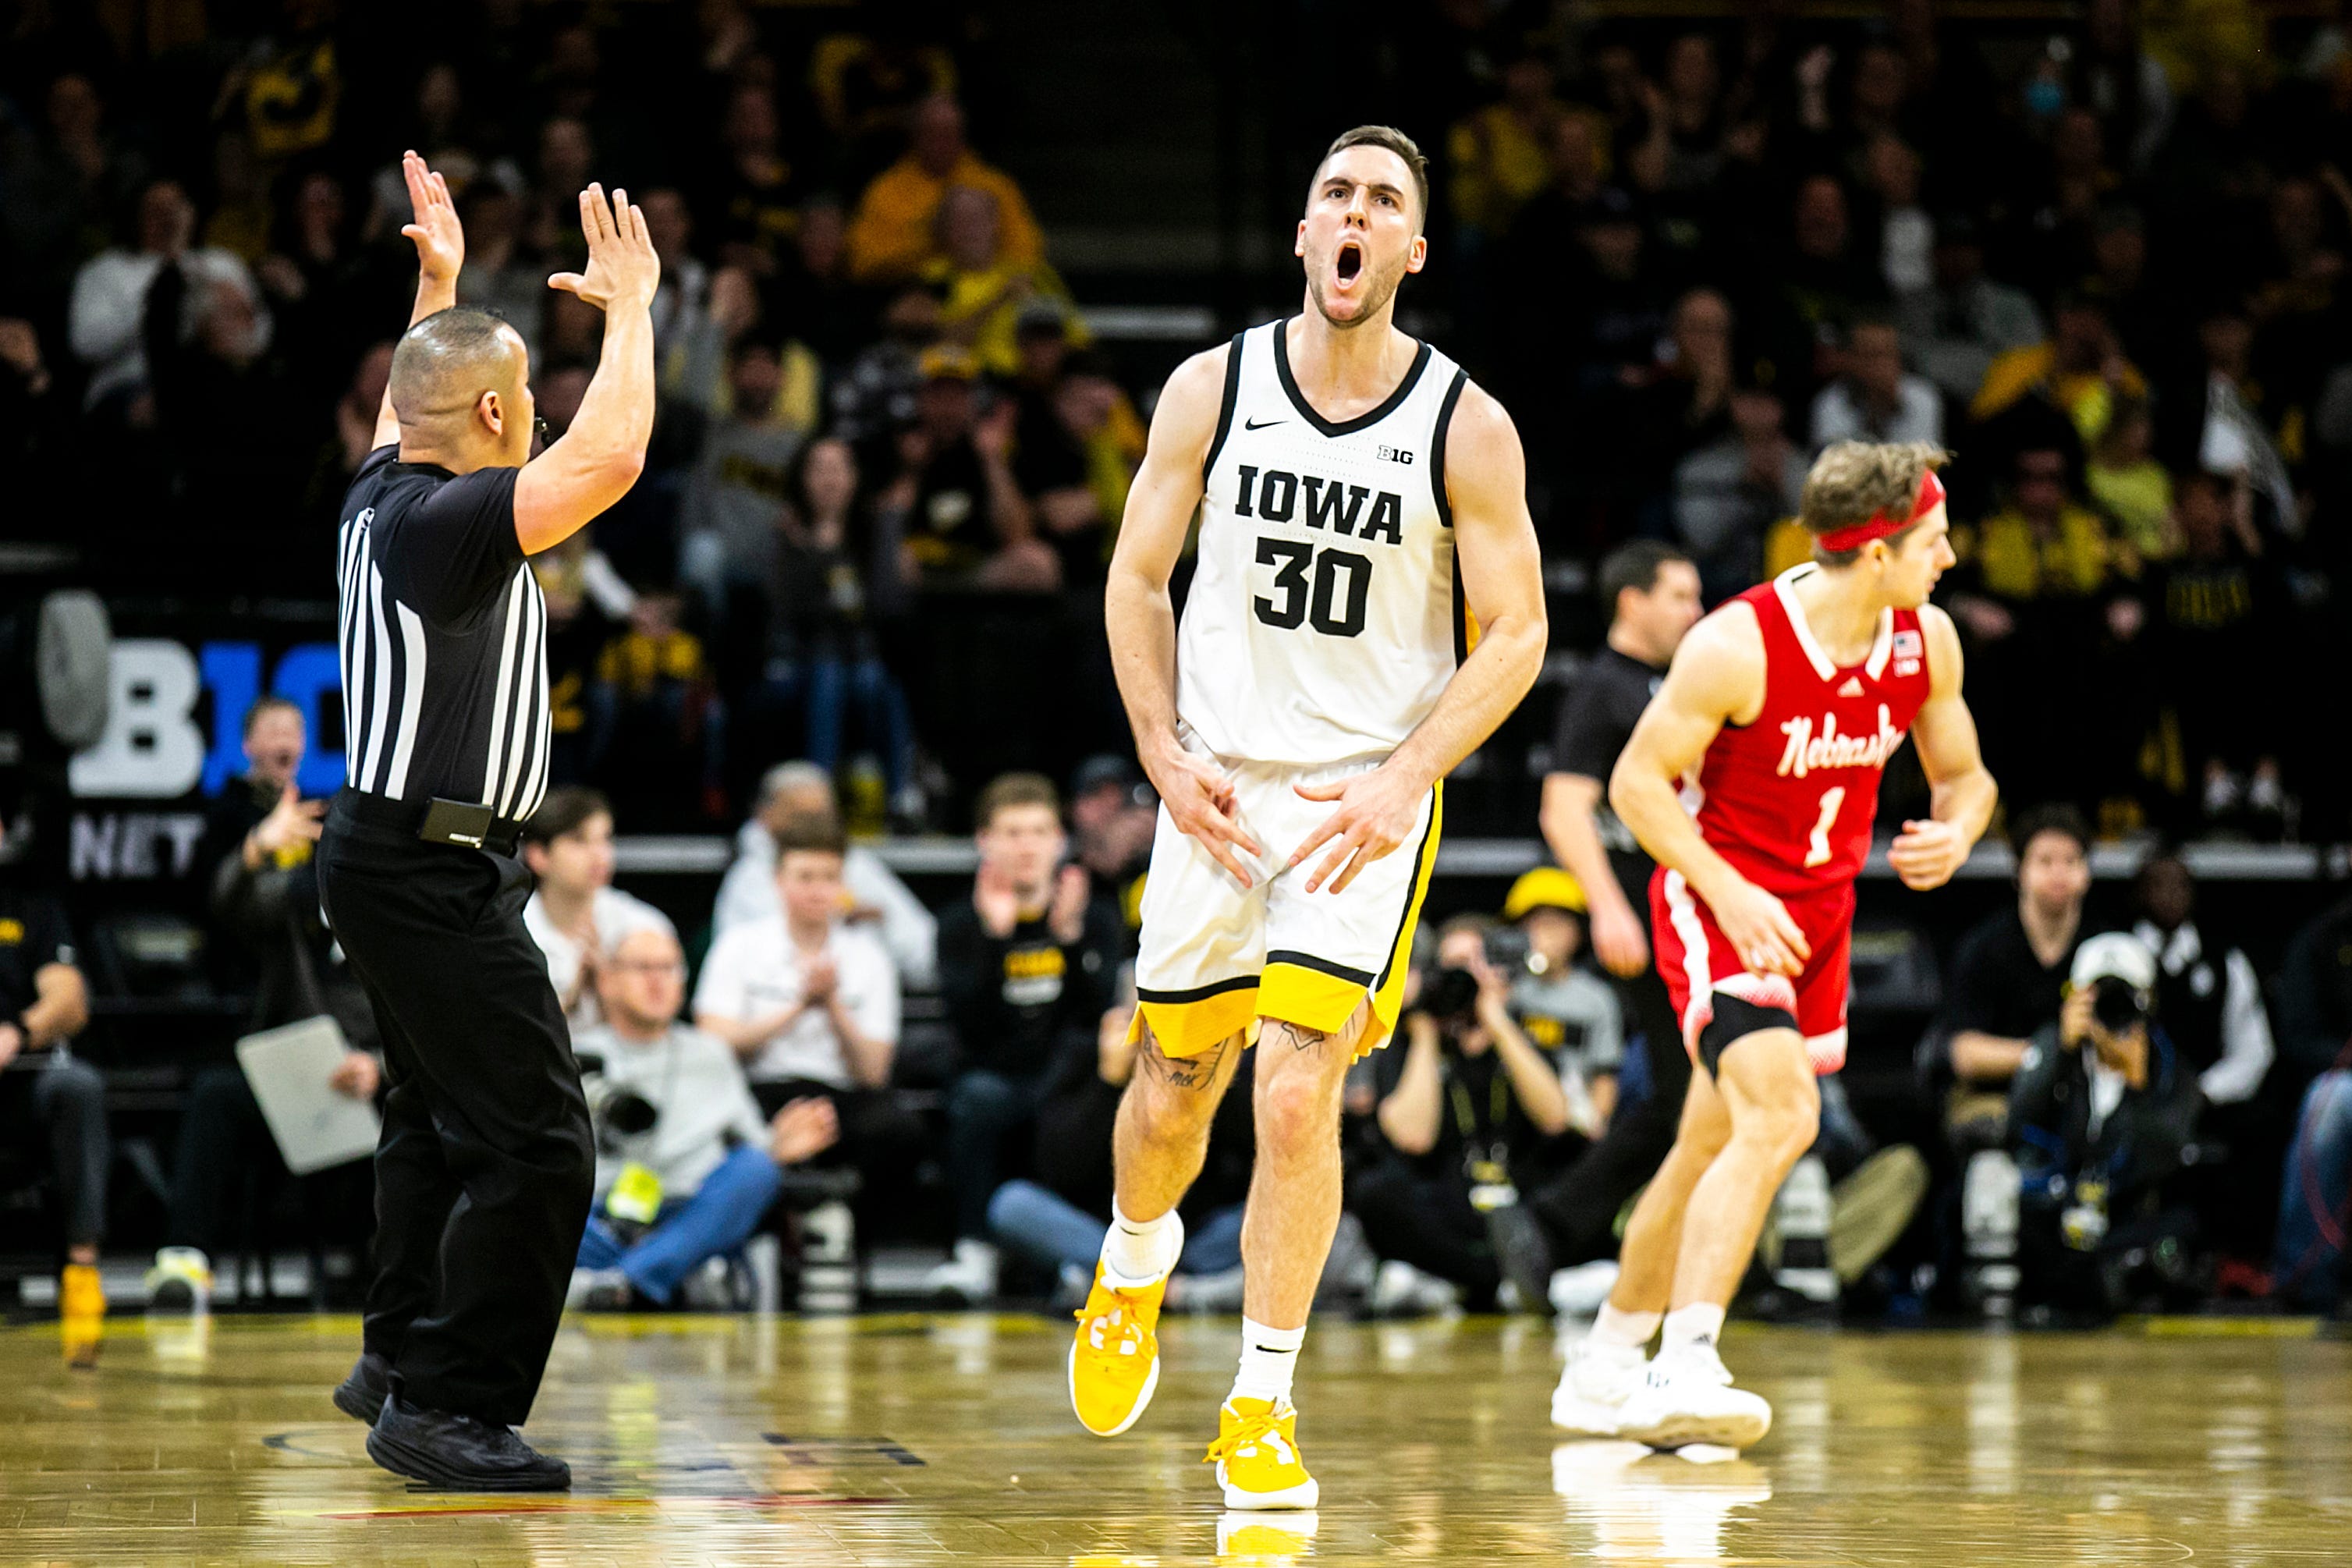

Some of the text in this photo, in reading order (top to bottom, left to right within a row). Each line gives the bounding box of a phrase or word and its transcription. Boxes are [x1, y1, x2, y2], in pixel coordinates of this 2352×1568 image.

[1235, 464, 1403, 545] IOWA
[1254, 537, 1373, 637] 30
[1776, 702, 1906, 779] Nebrask
[1804, 786, 1846, 868] 1
